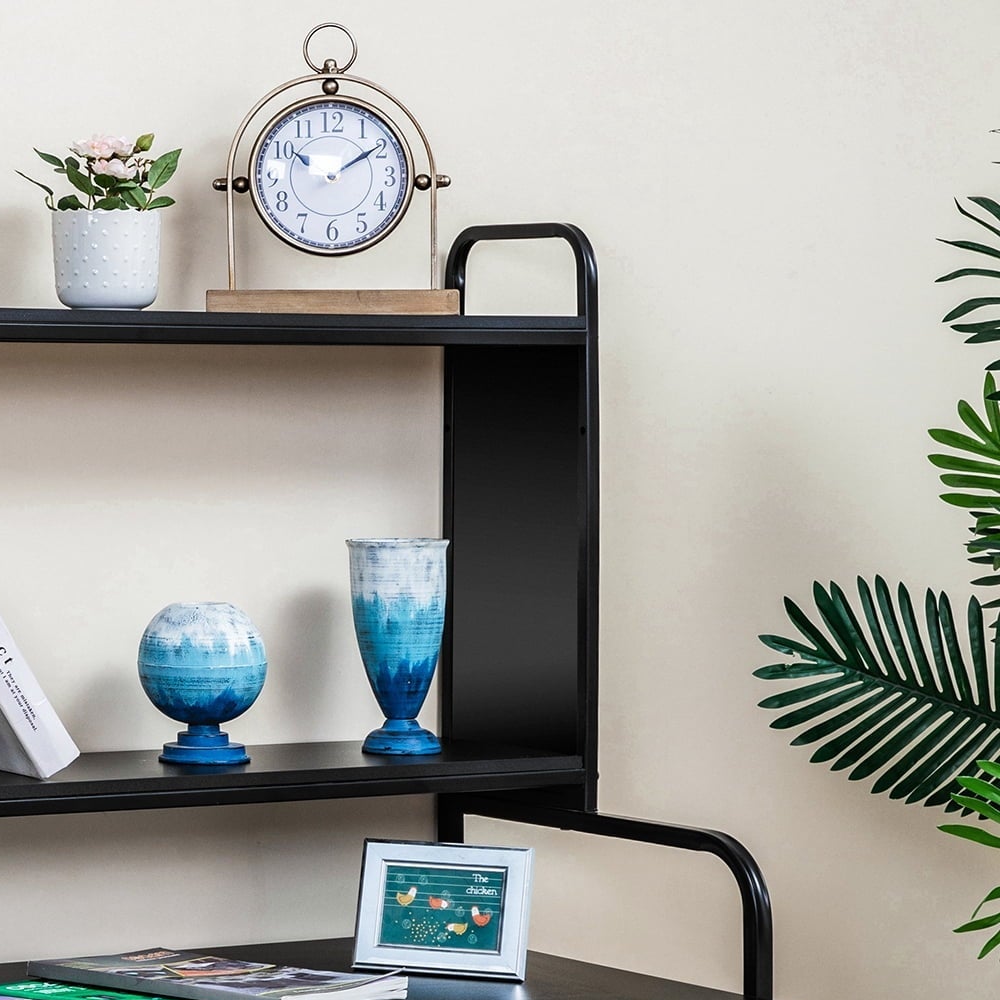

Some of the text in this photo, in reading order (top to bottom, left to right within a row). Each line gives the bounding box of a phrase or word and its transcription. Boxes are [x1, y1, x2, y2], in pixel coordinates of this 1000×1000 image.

[294, 119, 313, 139] 11
[320, 111, 344, 133] 12
[358, 118, 368, 139] 1
[273, 140, 294, 160] 10
[376, 138, 387, 159] 2
[267, 167, 279, 188] 9
[384, 166, 396, 187] 3
[276, 191, 288, 212] 8
[373, 190, 387, 211] 4
[296, 213, 308, 234] 7
[326, 219, 339, 241] 6
[356, 212, 368, 234] 5
[472, 873, 490, 883] The
[465, 886, 498, 896] chicken
